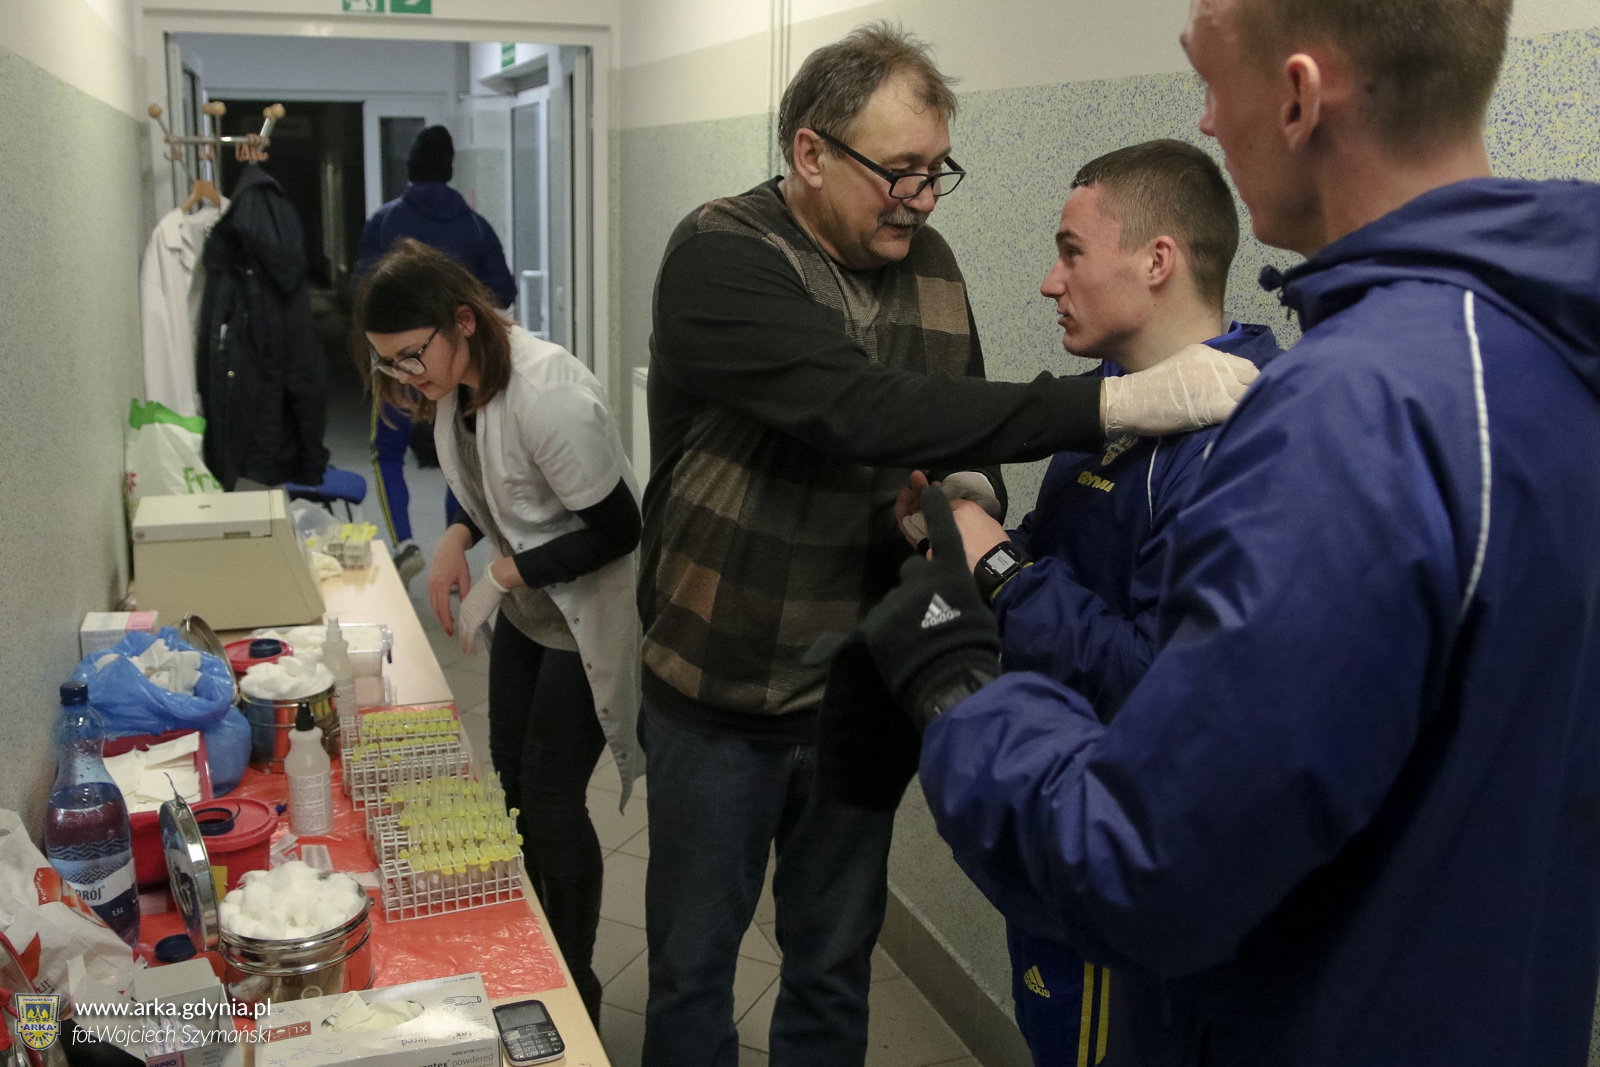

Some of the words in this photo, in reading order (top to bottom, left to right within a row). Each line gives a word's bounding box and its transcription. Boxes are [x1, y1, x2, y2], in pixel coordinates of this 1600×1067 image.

[921, 608, 961, 629] adidas
[292, 1024, 308, 1034] XL
[452, 1053, 494, 1067] powdered
